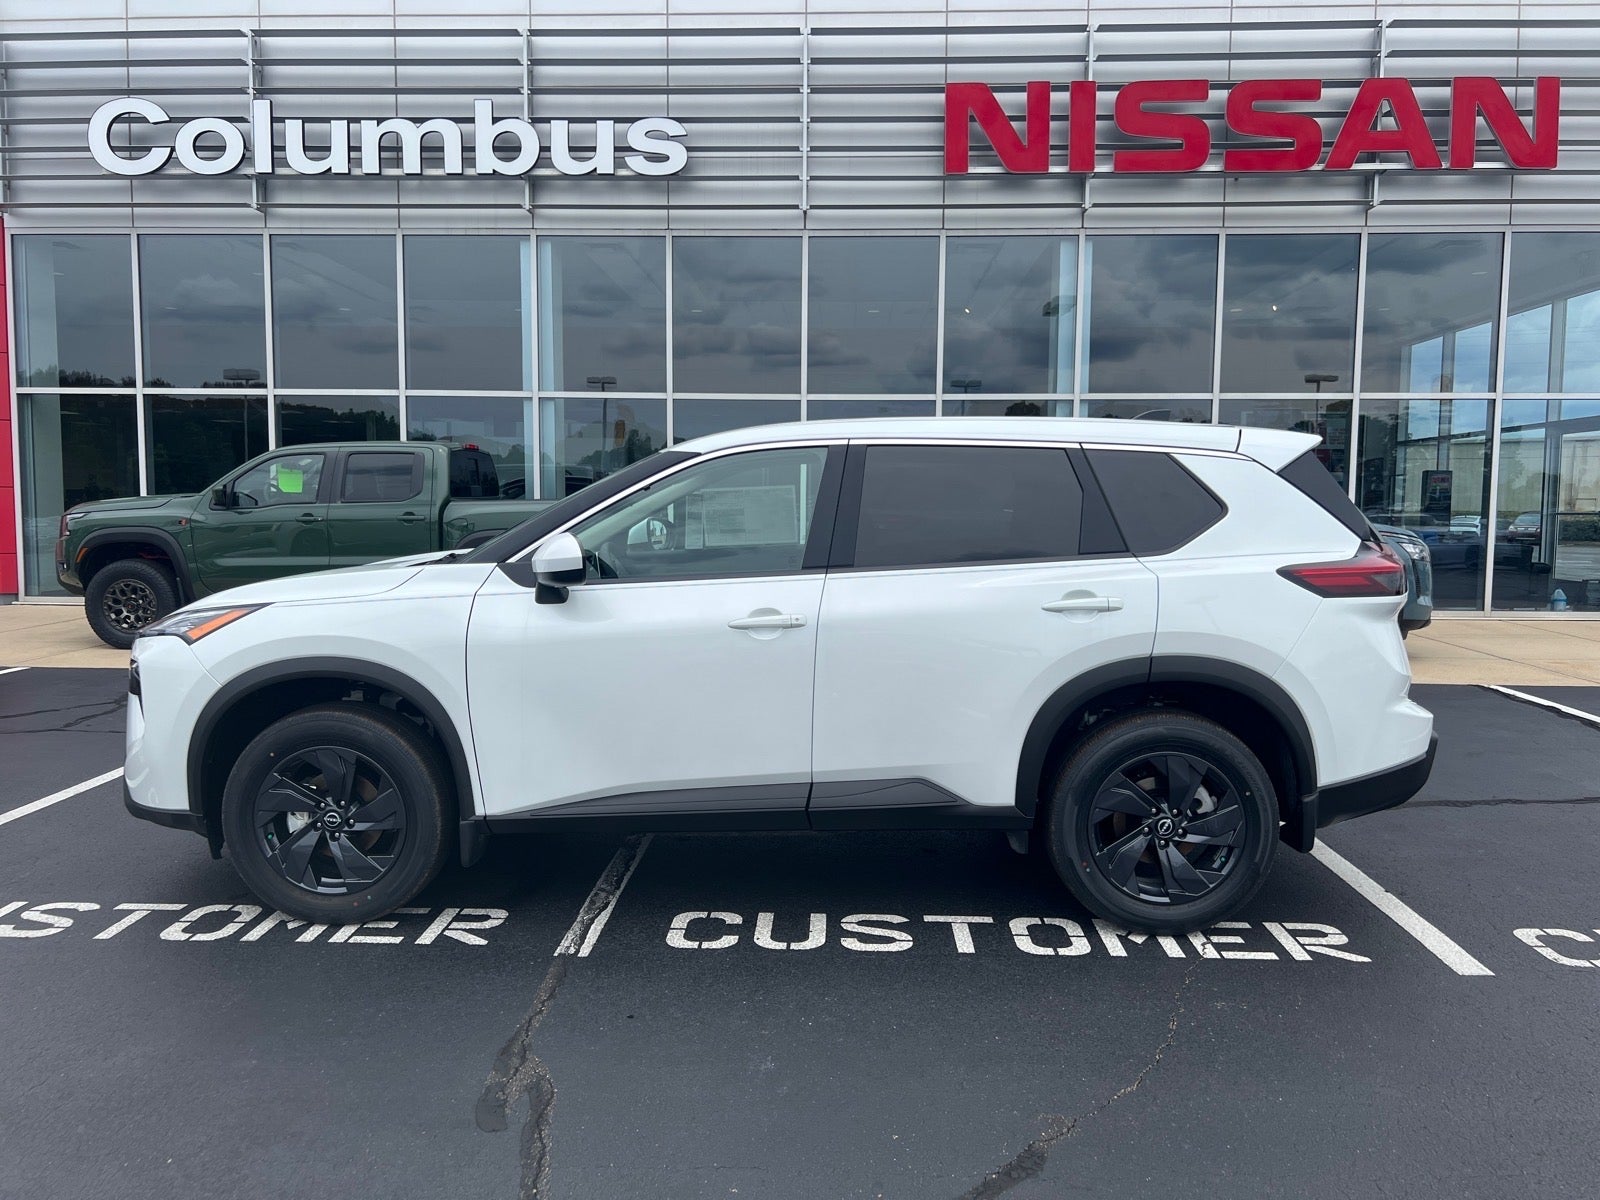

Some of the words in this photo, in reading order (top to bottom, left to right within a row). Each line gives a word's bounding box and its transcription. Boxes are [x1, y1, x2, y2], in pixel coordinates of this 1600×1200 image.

[87, 97, 689, 176] Columbus
[944, 76, 1560, 174] NISSAN
[0, 900, 510, 946] STOMER
